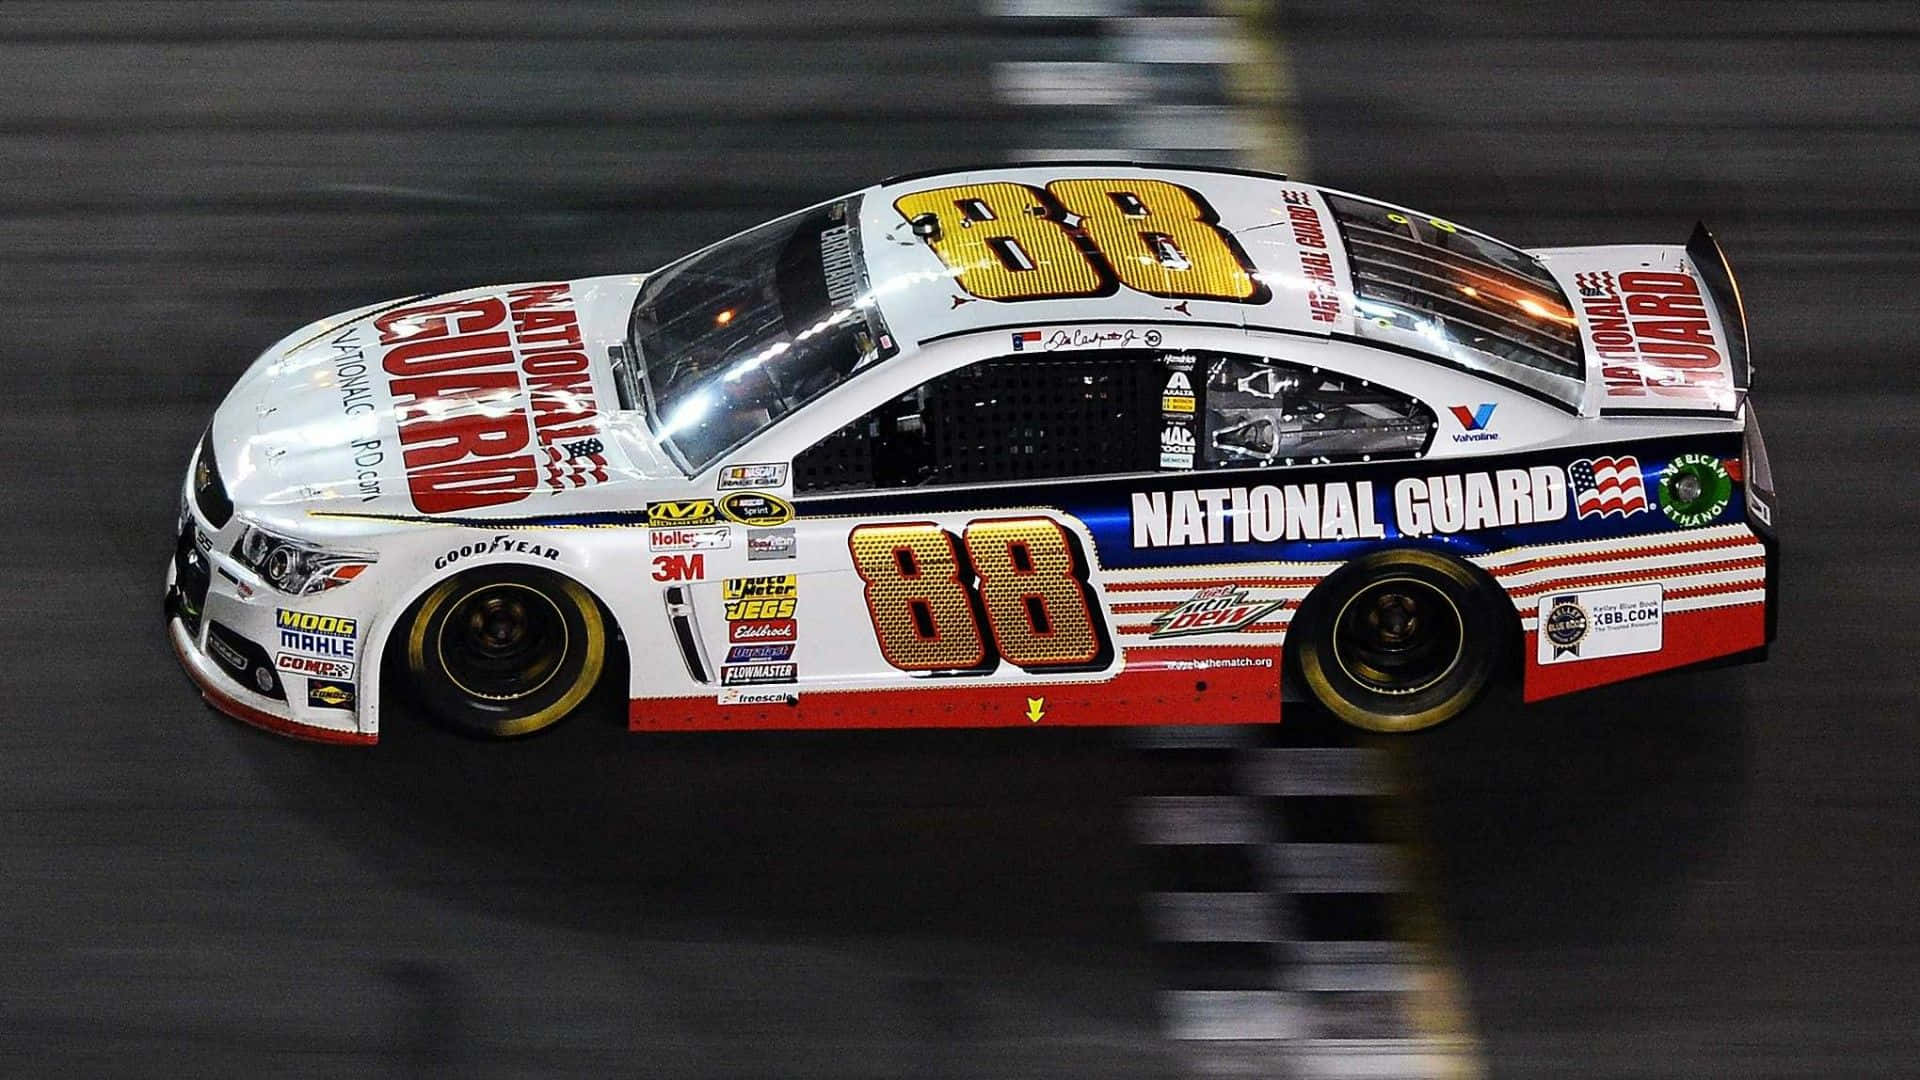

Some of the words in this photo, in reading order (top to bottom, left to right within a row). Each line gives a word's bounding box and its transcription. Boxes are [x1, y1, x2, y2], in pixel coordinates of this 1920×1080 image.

[1287, 205, 1327, 248] GUARD
[894, 178, 1266, 304] 88
[821, 225, 857, 307] EARNHARDT
[1582, 294, 1646, 396] NATIONAL
[1619, 272, 1726, 399] GUARD
[507, 283, 598, 447] NATIONAL
[373, 297, 539, 515] GUARD
[1452, 433, 1499, 443] Valvoline
[1660, 454, 1728, 486] AMERICAN
[744, 507, 769, 516] Sprint
[1131, 481, 1385, 548] NATIONAL
[1395, 465, 1567, 538] GUARD
[1662, 500, 1728, 527] ETHANOL
[434, 534, 560, 570] GOODYEAR
[651, 554, 704, 582] 3M
[726, 600, 797, 619] JEGS
[848, 516, 1116, 677] 88
[280, 609, 354, 635] MOOG
[735, 624, 792, 638] Edelbrock
[281, 631, 355, 657] MAHLE
[279, 656, 334, 674] COMP
[726, 664, 794, 684] FLOWMASTER
[739, 692, 792, 704] freescale
